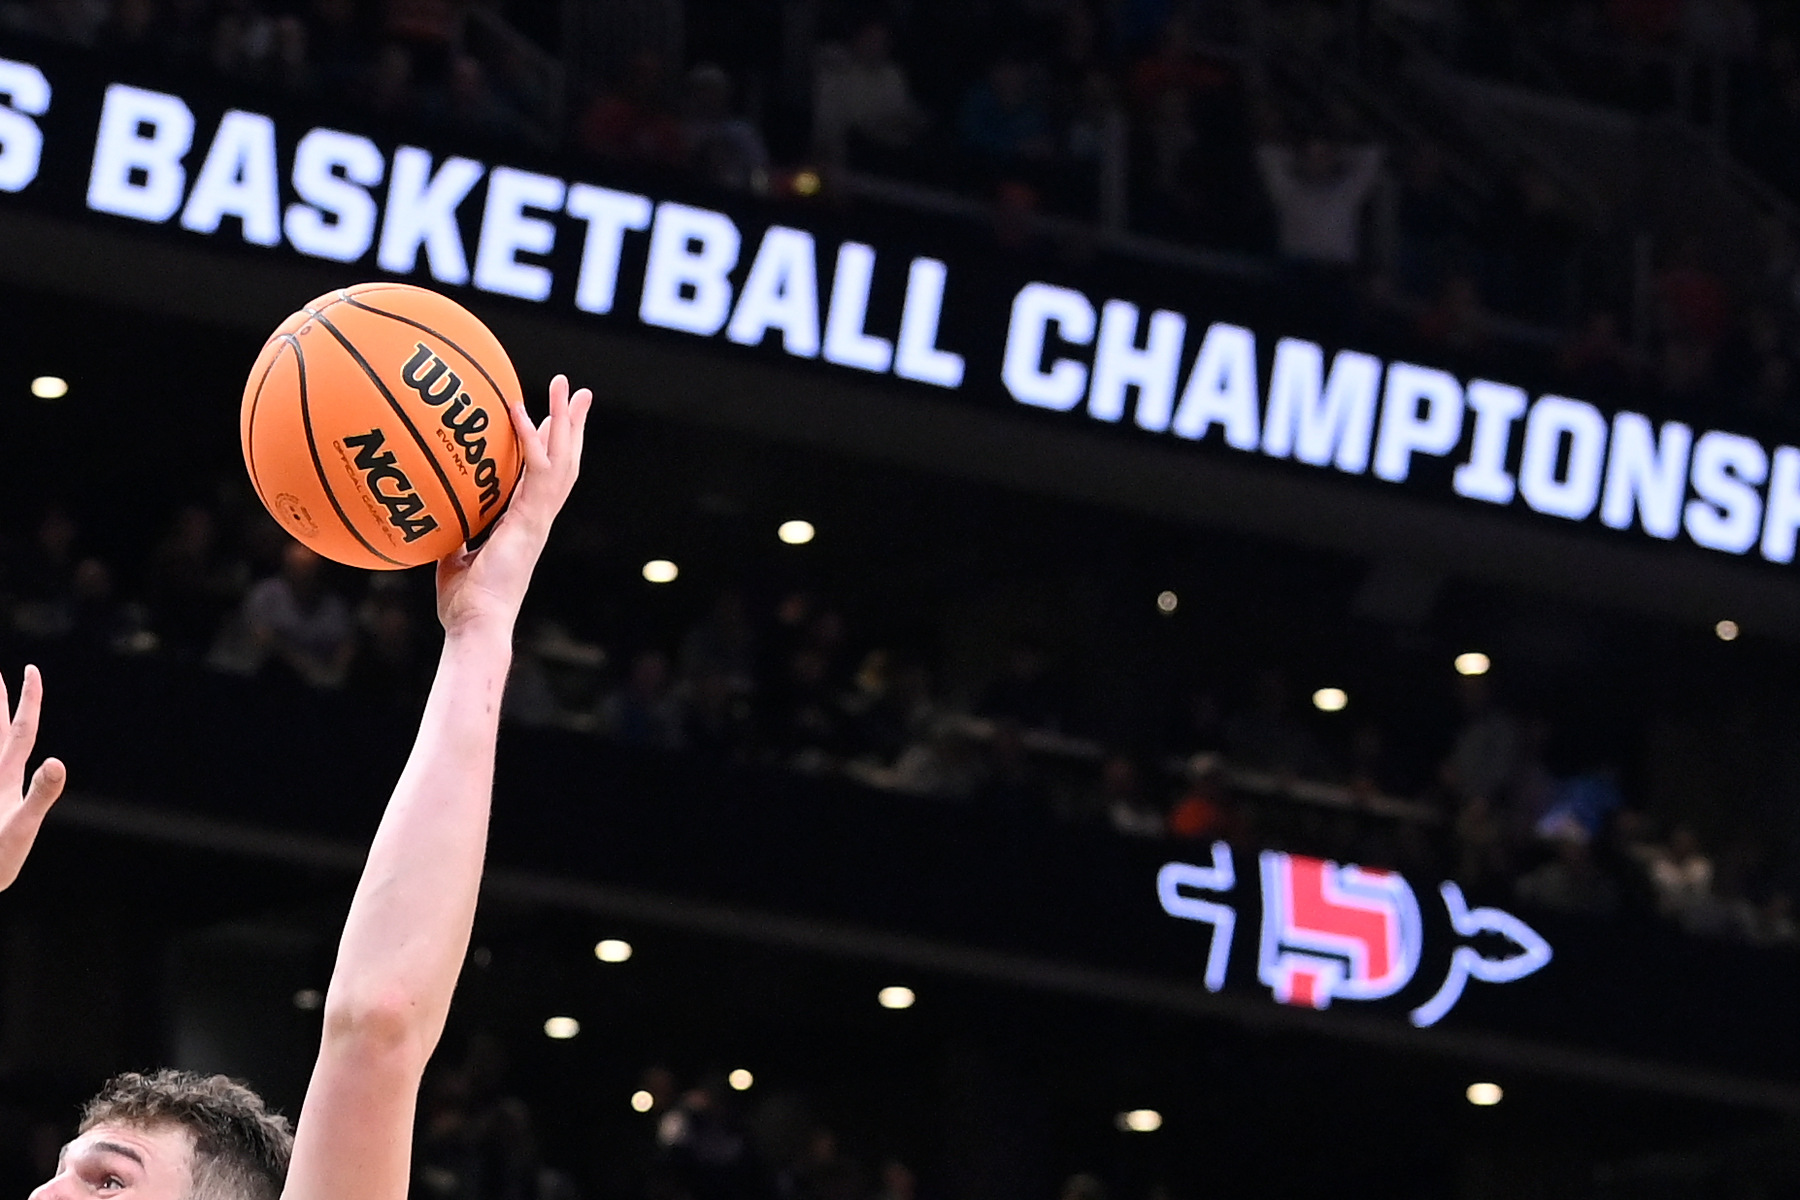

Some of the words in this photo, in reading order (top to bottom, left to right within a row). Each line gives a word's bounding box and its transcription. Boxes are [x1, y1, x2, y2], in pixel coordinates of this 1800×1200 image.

[85, 83, 965, 388] BASKETBALL
[341, 427, 440, 544] NCAA
[400, 339, 500, 520] Wilson
[435, 428, 455, 452] EVO
[452, 452, 469, 478] NXT
